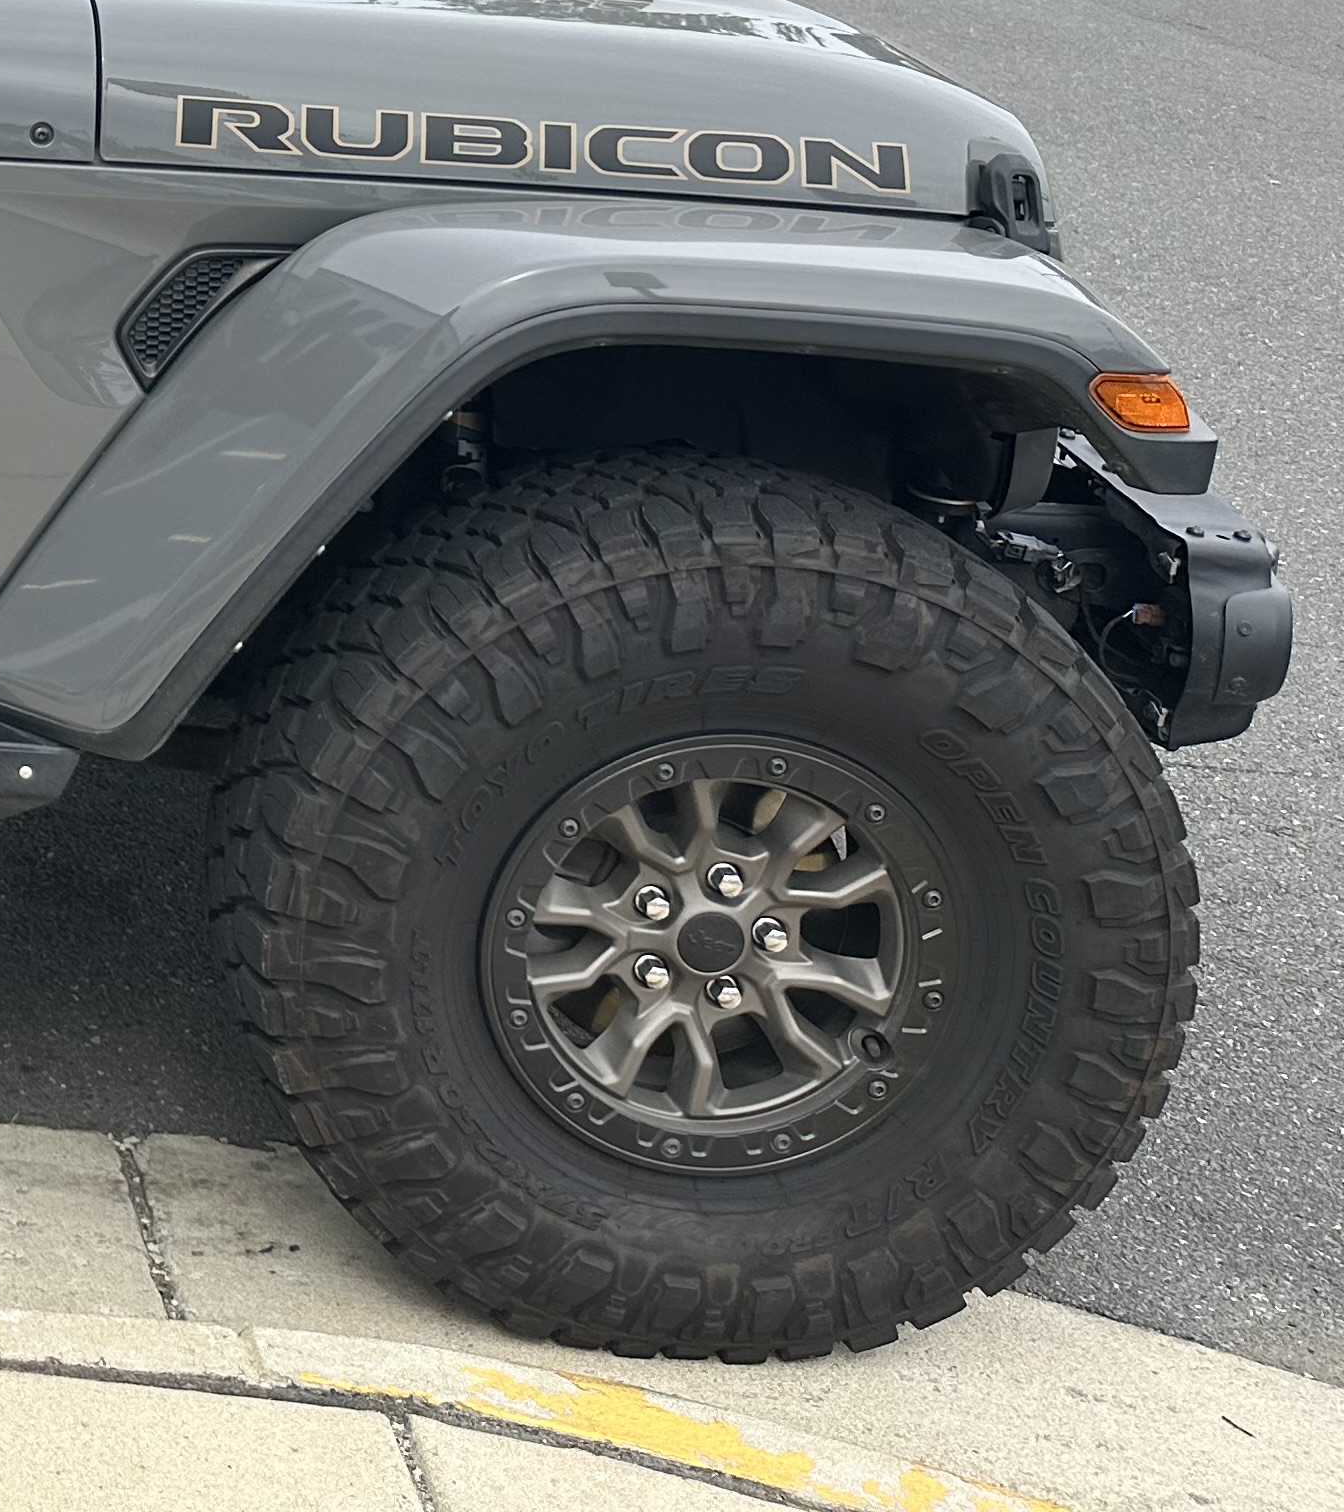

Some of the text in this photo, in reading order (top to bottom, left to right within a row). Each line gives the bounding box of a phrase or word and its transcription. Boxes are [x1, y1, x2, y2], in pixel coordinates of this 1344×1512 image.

[175, 94, 912, 193] RUBICON
[433, 664, 806, 869] TOYO TIRES
[918, 728, 1049, 867] OPEN
[966, 876, 1066, 1157] COUNTRY
[845, 1151, 950, 1238] R/T
